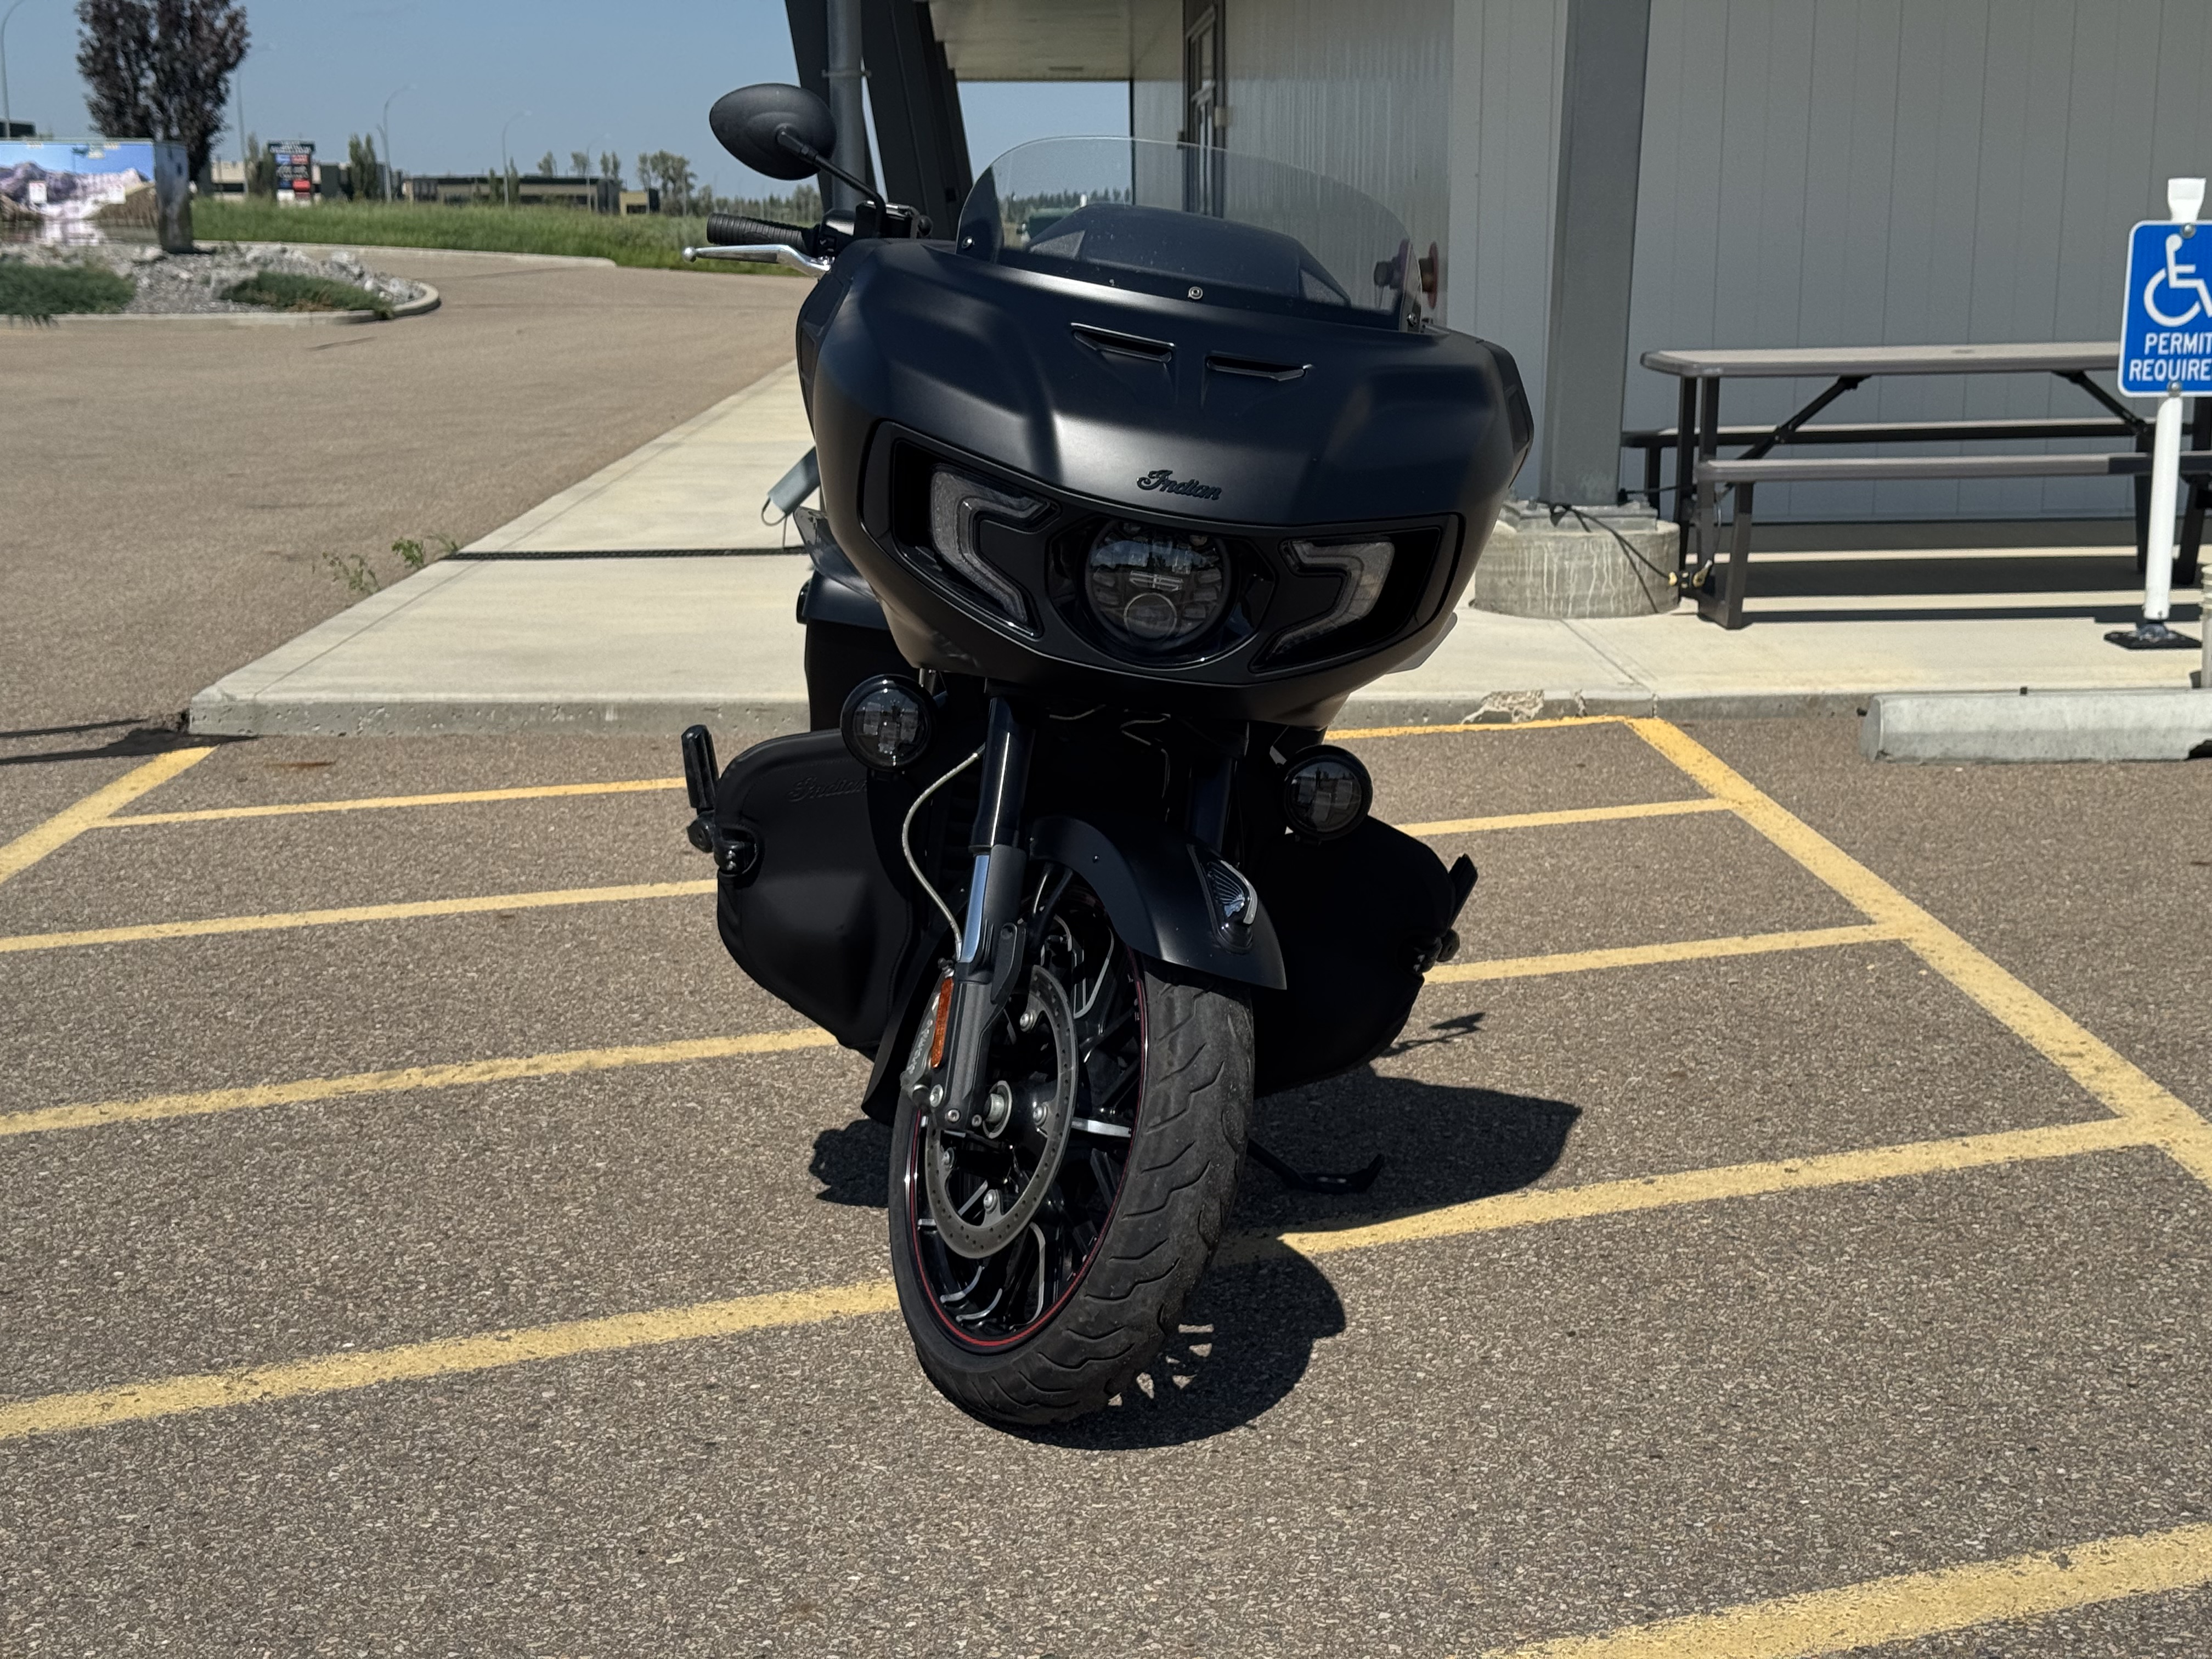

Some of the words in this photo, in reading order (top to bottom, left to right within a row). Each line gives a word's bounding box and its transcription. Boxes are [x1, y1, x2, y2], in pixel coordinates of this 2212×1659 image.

[2144, 332, 2212, 356] PERMIT
[2129, 358, 2212, 382] REQUIRE
[1137, 470, 1222, 500] Indian
